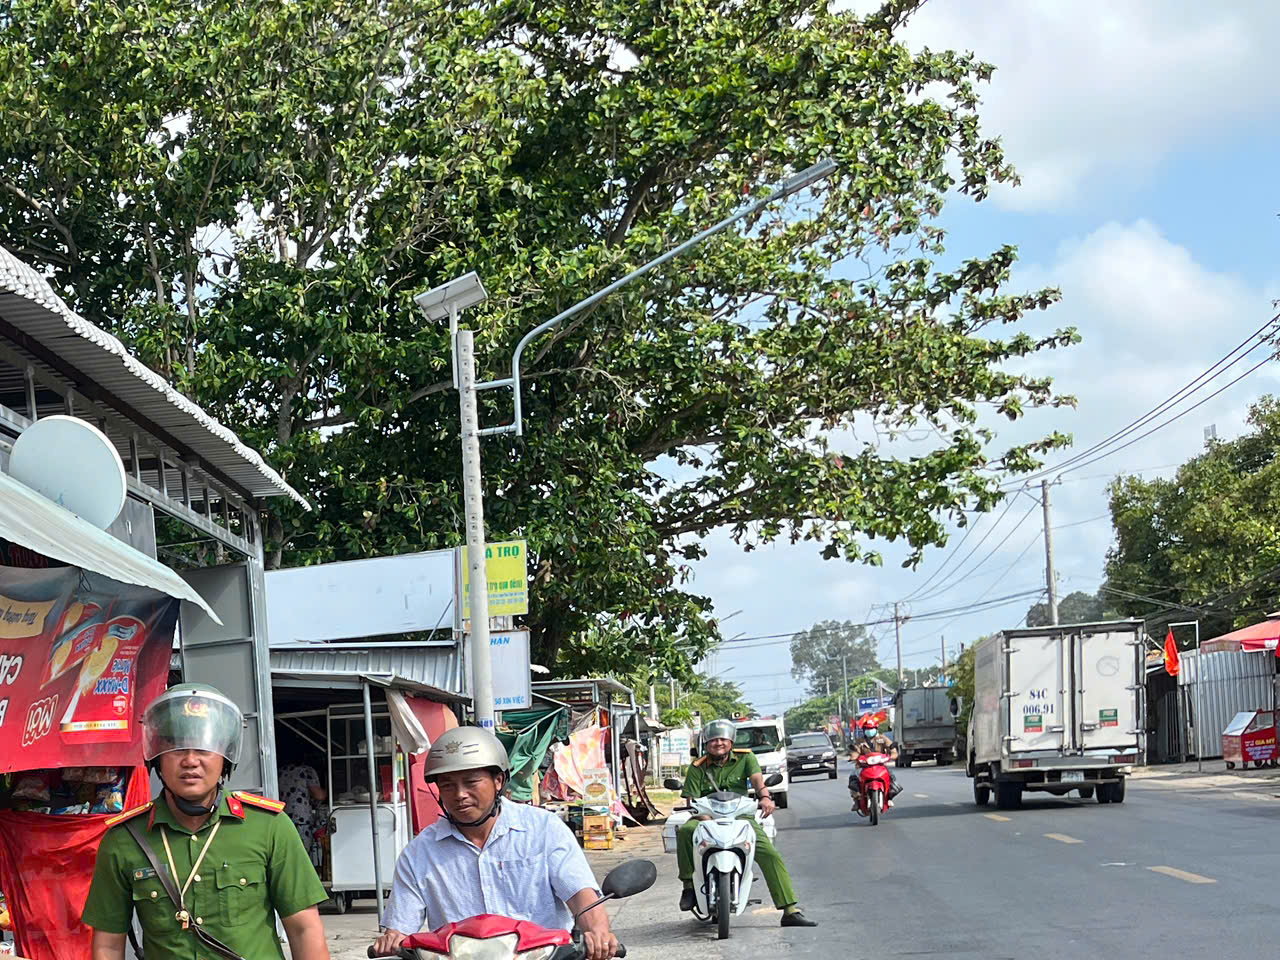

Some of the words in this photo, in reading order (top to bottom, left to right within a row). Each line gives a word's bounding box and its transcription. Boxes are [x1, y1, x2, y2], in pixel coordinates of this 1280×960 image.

[1029, 688, 1048, 699] 84C
[1023, 704, 1054, 714] 006.91
[23, 696, 57, 743] Mới
